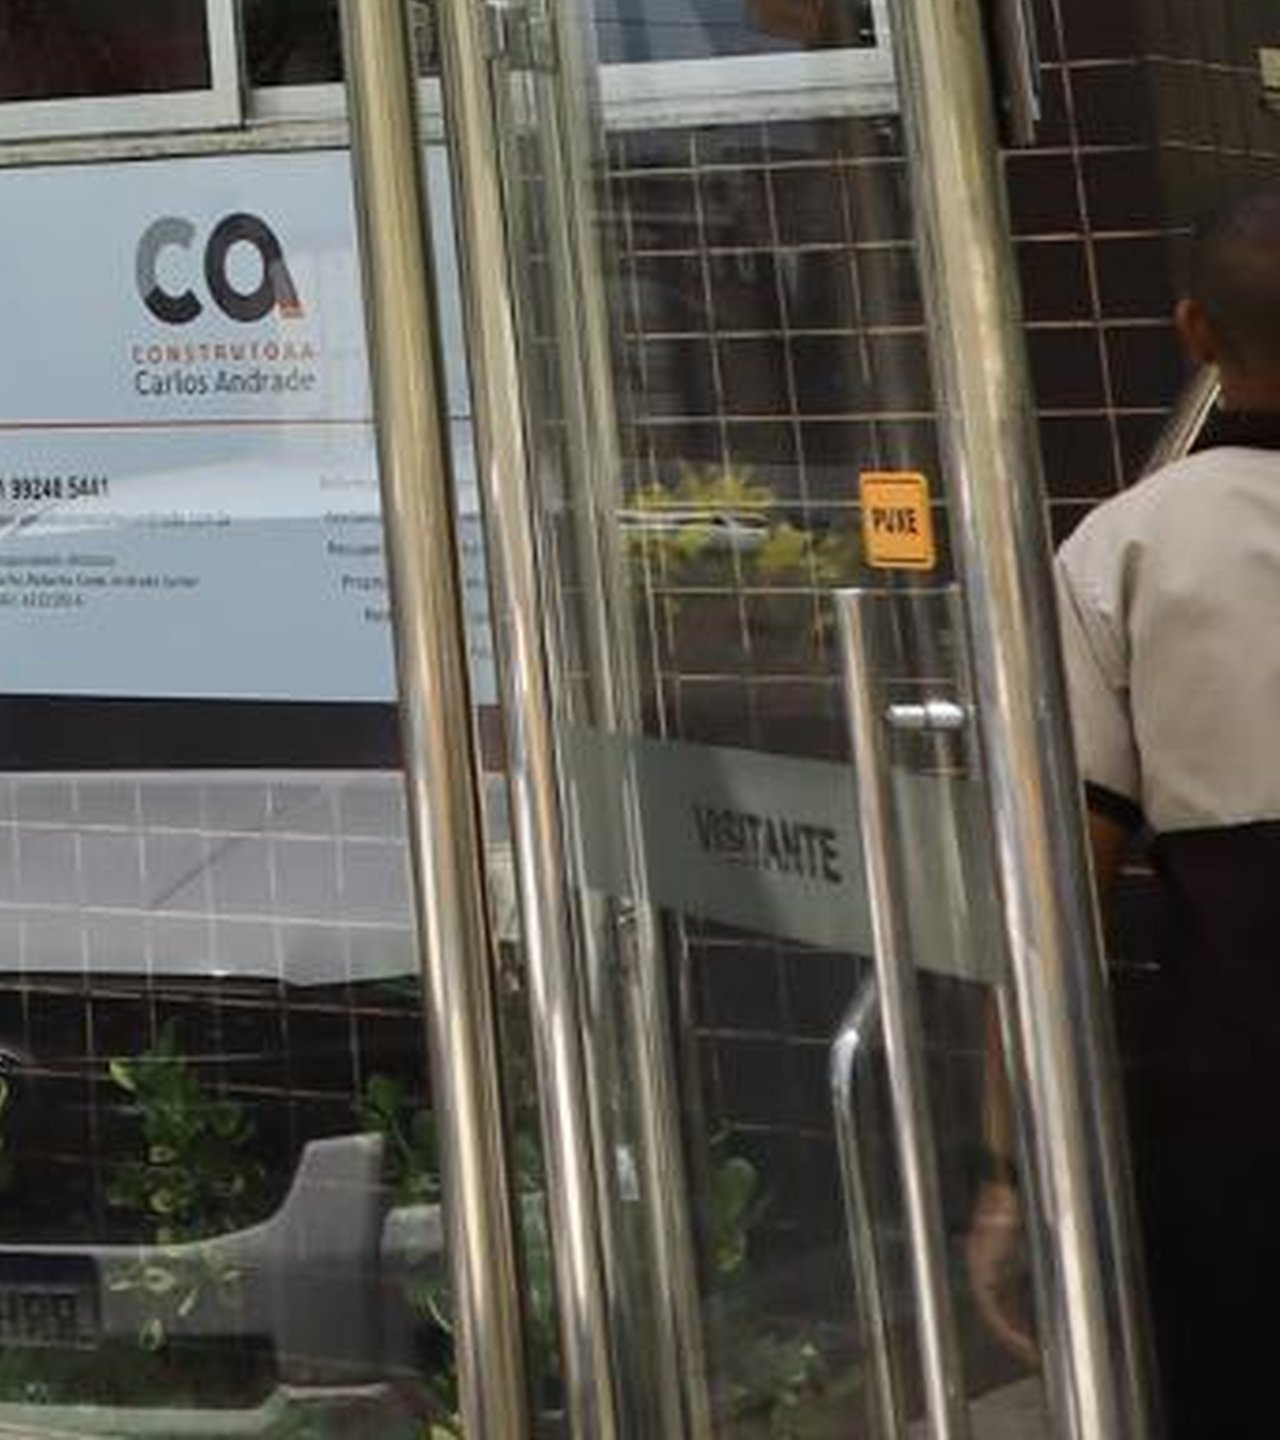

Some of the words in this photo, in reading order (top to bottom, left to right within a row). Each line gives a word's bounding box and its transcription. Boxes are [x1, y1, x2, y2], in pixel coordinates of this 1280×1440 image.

[132, 342, 318, 365] CONSTRUTORA
[134, 369, 208, 395] Carlos
[214, 366, 317, 393] Andrade
[692, 806, 842, 884] VISITANTE
